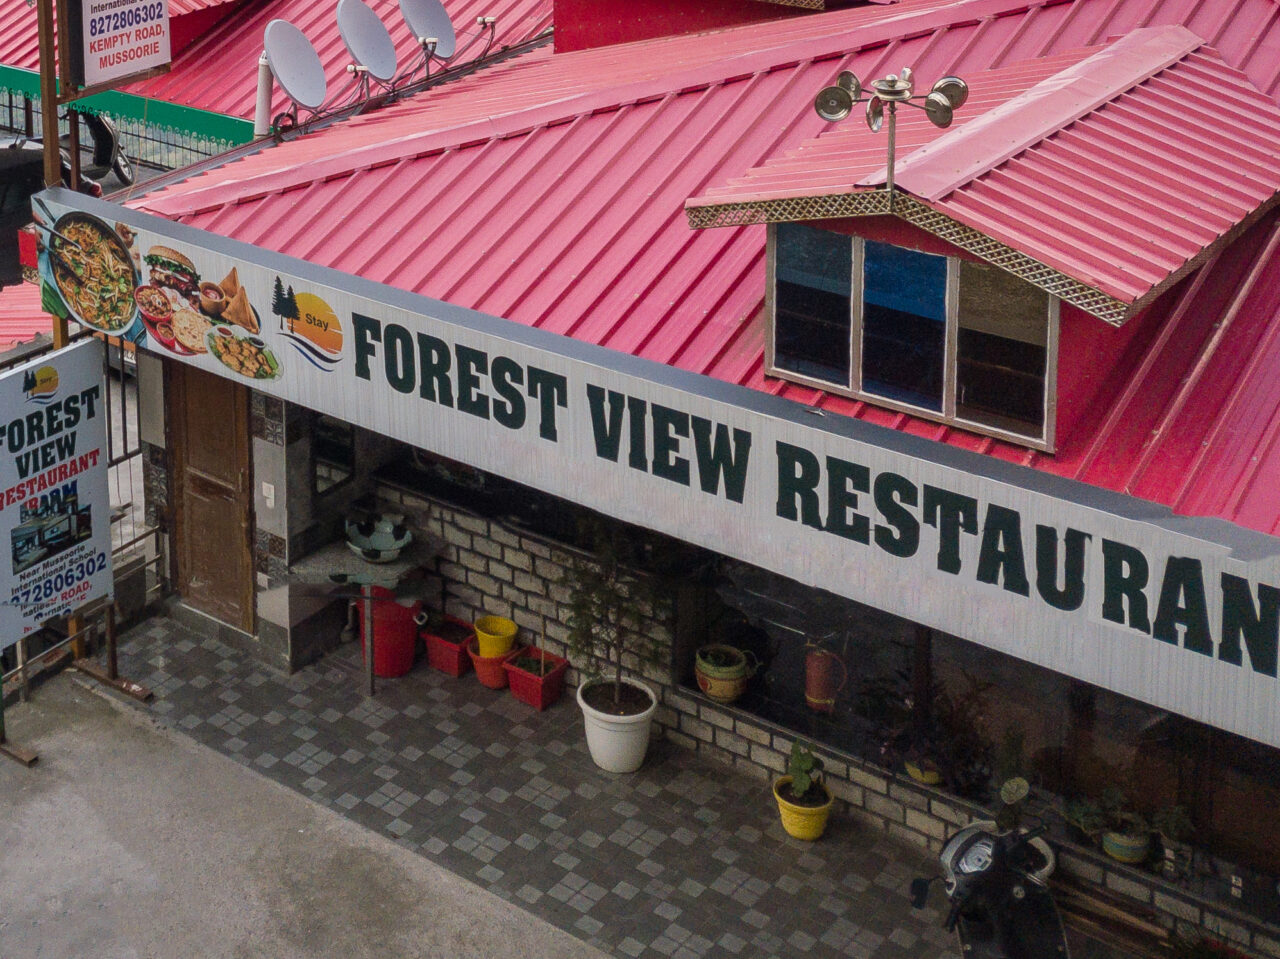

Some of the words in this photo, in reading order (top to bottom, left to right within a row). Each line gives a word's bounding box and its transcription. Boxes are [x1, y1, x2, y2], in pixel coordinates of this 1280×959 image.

[89, 2, 163, 37] 8272806302
[89, 32, 131, 54] KEMPTY
[135, 23, 165, 42] ROAD,
[99, 41, 160, 69] MUSSOORIE
[306, 312, 329, 332] Stay
[351, 312, 568, 443] FOREST
[586, 383, 752, 504] VIEW
[15, 431, 77, 479] VIEW
[4, 552, 107, 605] 272806302
[11, 562, 66, 595] International
[68, 547, 97, 567] School
[20, 567, 40, 582] Near
[42, 544, 85, 570] Mussoorie
